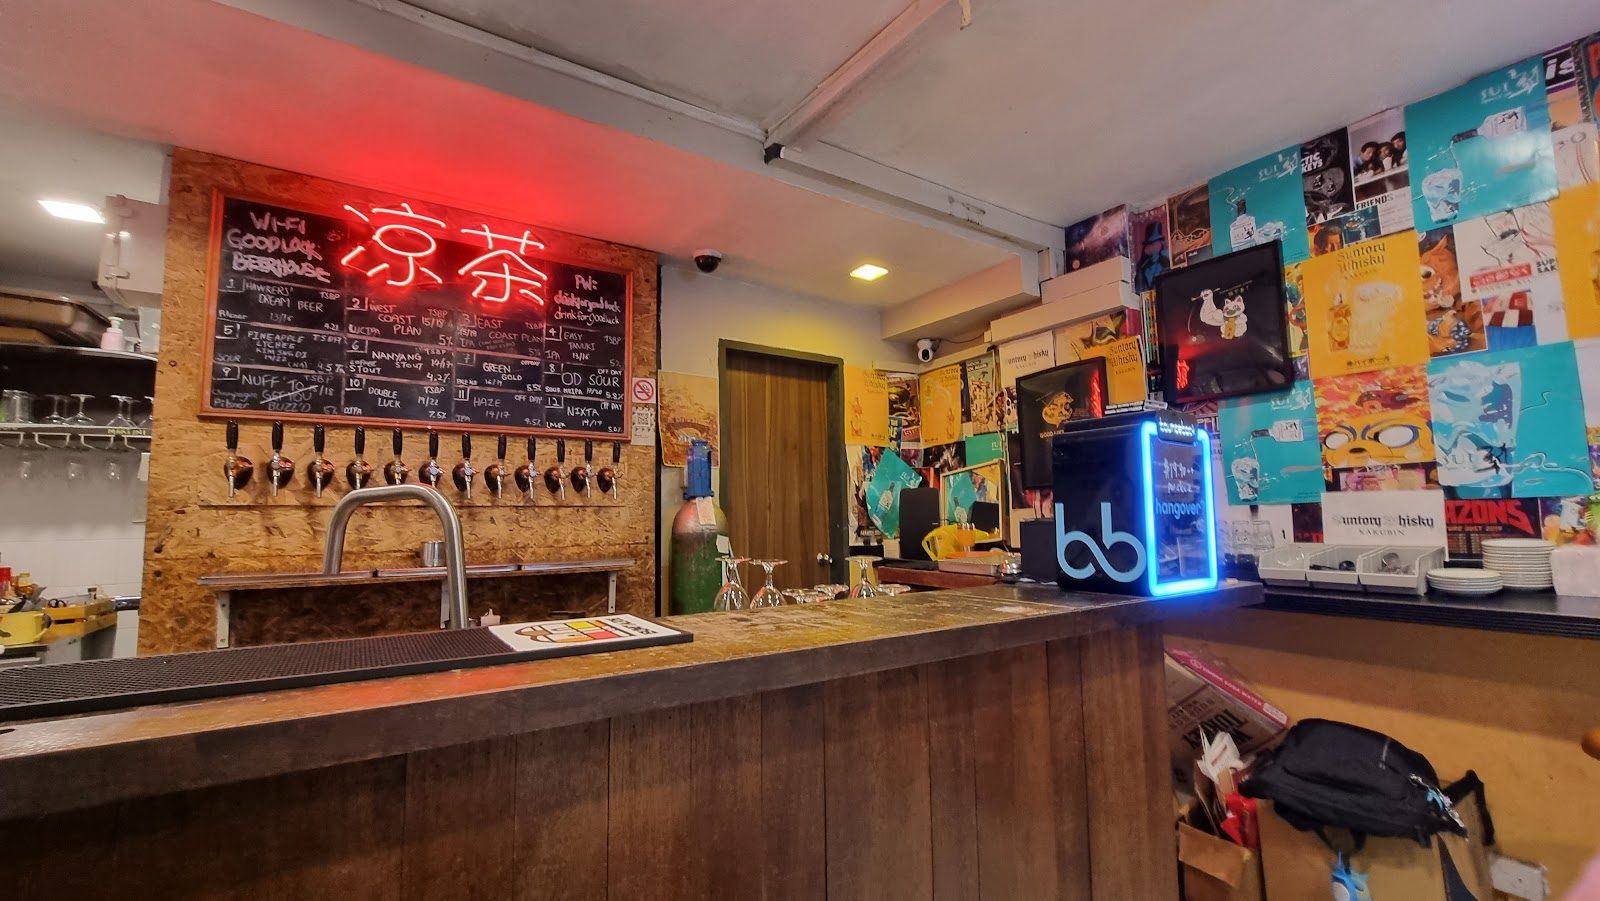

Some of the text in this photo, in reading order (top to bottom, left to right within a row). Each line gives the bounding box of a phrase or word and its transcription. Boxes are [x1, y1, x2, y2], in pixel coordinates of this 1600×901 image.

[1300, 152, 1321, 164] TIC
[250, 212, 306, 234] WI-FI
[232, 252, 331, 283] BEERHOUSE
[1536, 258, 1558, 268] SUP
[1537, 266, 1558, 274] SAK
[259, 294, 323, 312] DREAM BEER
[352, 298, 360, 308] 2
[369, 303, 397, 313] WEST
[378, 314, 416, 324] COAST
[463, 313, 470, 323] 3
[478, 319, 504, 329] EAST
[224, 325, 234, 335] 5
[393, 325, 421, 336] PLAN
[549, 328, 557, 336] 4
[248, 331, 304, 343] PINEAPPLE
[489, 331, 544, 343] COAST PLAN
[564, 332, 583, 341] EASY
[256, 341, 296, 349] LYCHEE
[352, 340, 359, 350] 6
[568, 342, 595, 351] TANUKI
[372, 351, 422, 361] NANYANG
[545, 350, 560, 359] IPA
[350, 365, 381, 374] STOUT
[395, 362, 423, 370] STOUT
[483, 362, 511, 373] GREEN
[549, 364, 555, 373] 8
[242, 375, 304, 390] NUFF TO
[350, 379, 360, 387] 10
[561, 372, 620, 387] OD SOUR
[368, 387, 398, 398] DOUBLE
[545, 385, 560, 393] SOUR
[378, 398, 400, 408] LUCK
[473, 397, 501, 407] HAZE
[567, 406, 600, 417] NIXTA
